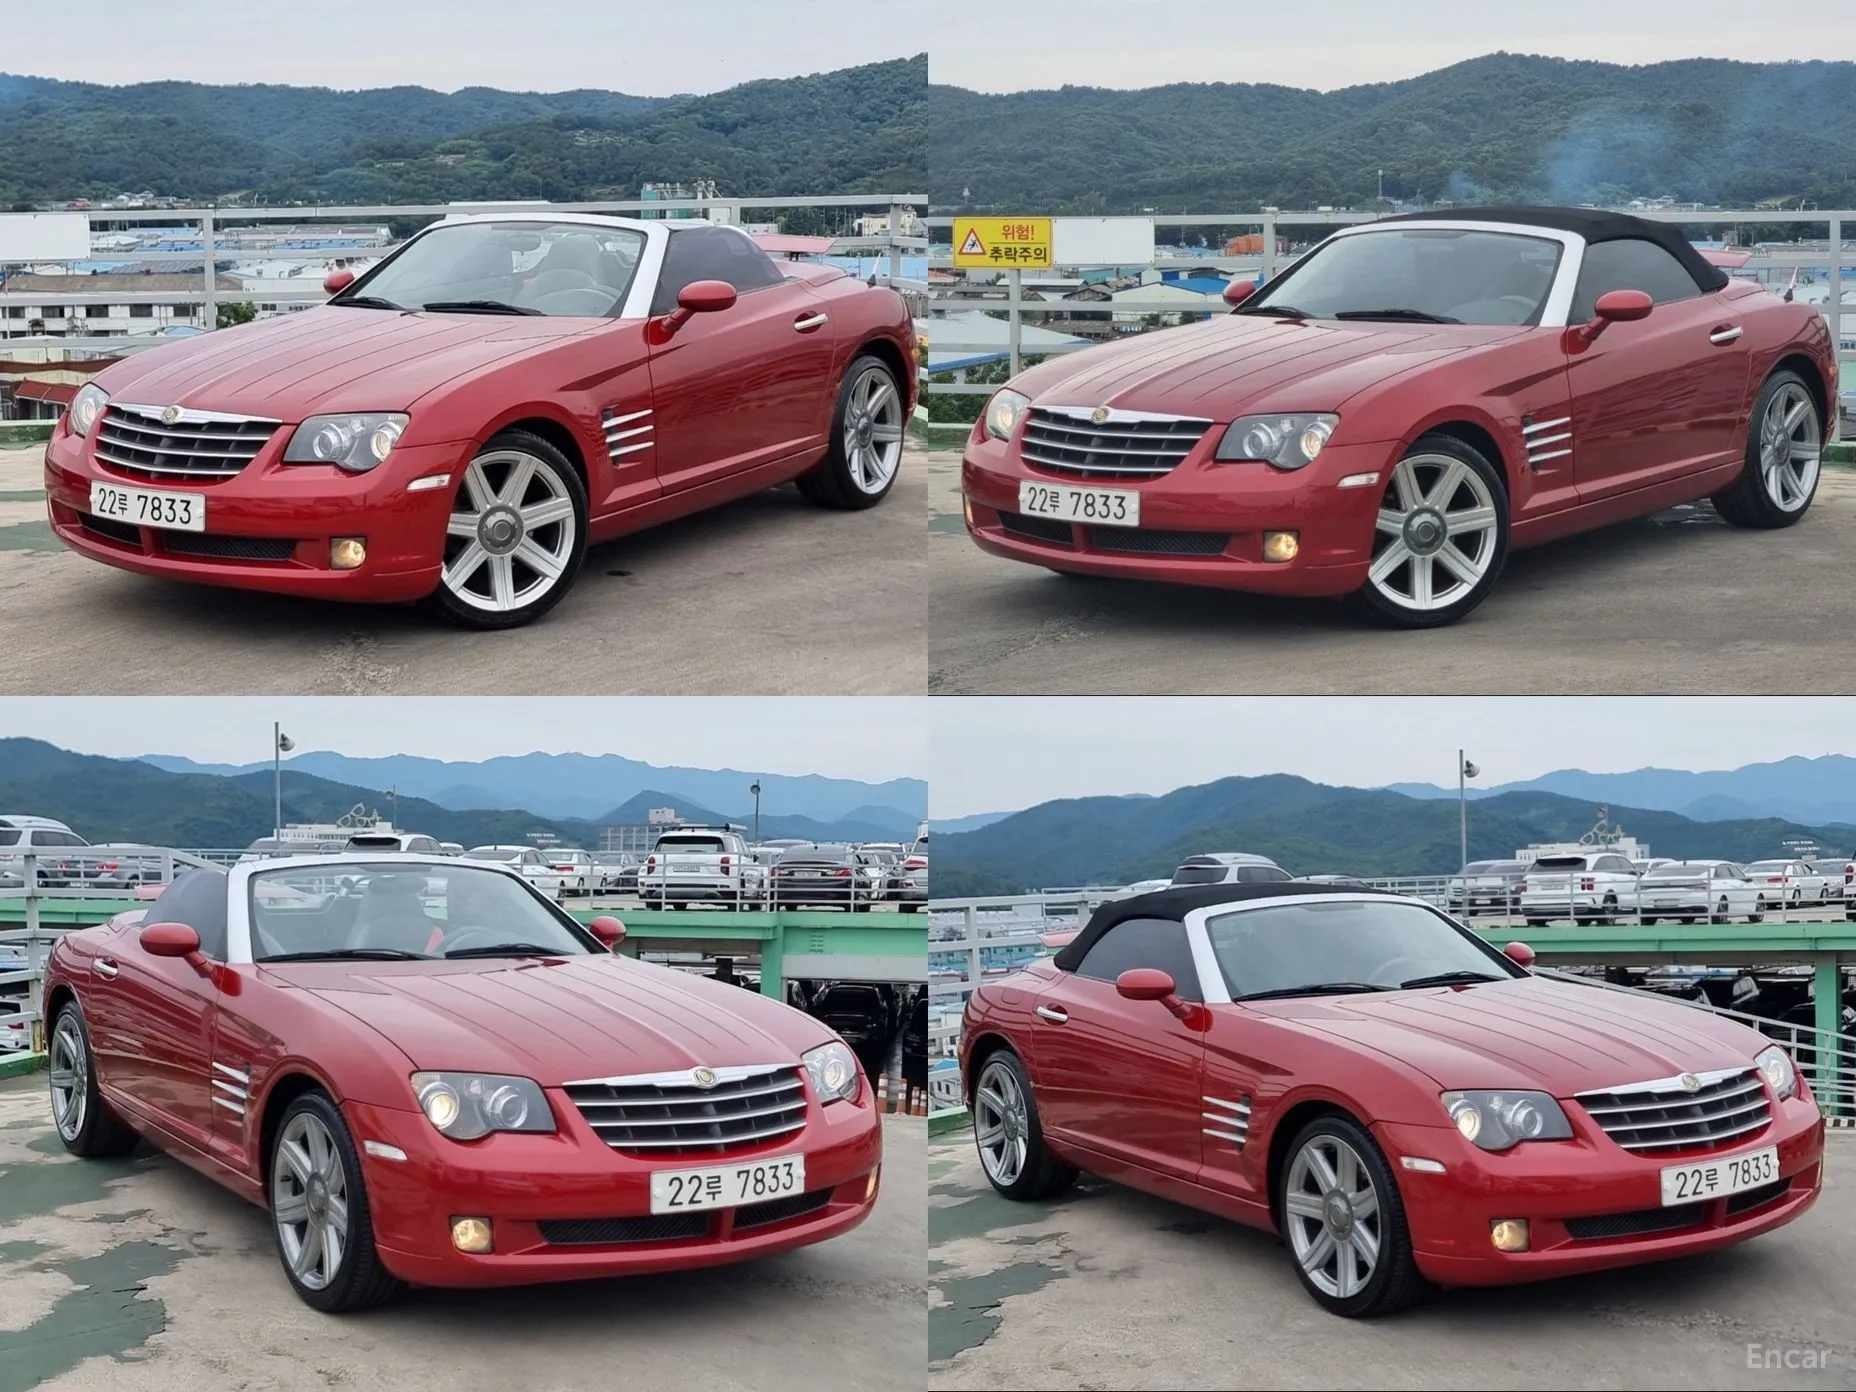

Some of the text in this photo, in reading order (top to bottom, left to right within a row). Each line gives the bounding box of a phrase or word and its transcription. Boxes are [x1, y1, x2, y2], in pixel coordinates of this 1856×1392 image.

[1002, 224, 1034, 240] 위험!
[989, 247, 1047, 262] 추락주의
[98, 488, 192, 524] 22루 7833
[1028, 486, 1126, 520] 22루 7833
[668, 1162, 793, 1206] 22루 7833
[1675, 1154, 1771, 1199] 22루 7833
